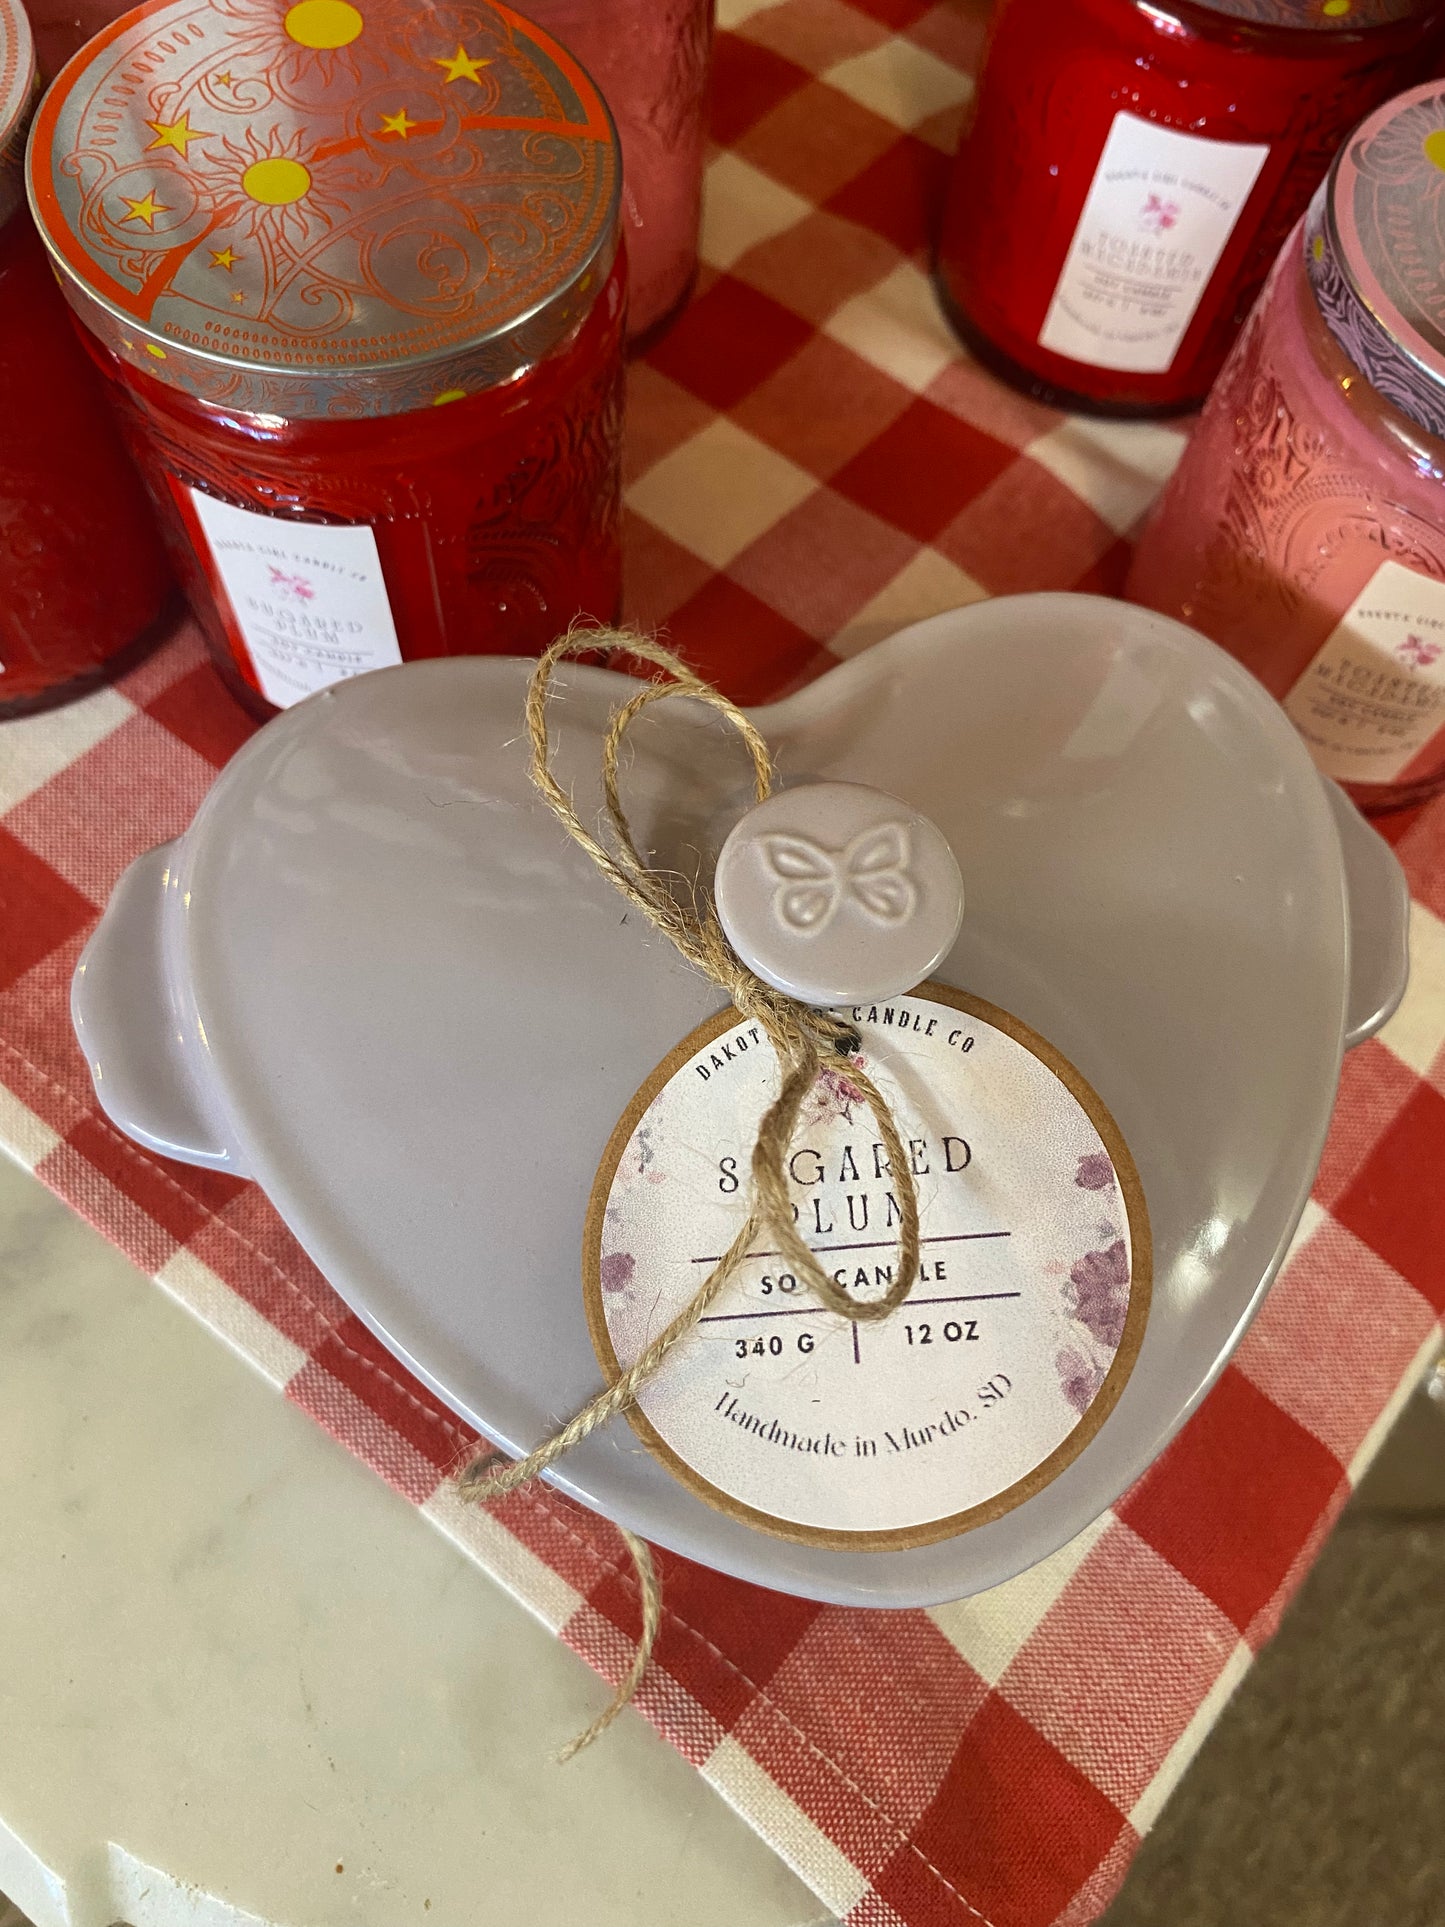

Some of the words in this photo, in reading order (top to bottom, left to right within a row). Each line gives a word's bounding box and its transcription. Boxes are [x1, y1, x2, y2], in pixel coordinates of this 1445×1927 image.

[695, 1027, 760, 1081] DAKOT
[852, 1006, 938, 1037] CANDLE
[948, 1029, 976, 1053] CO
[718, 1136, 973, 1194] SGARED
[760, 1273, 797, 1295] SO
[833, 1260, 948, 1289] CANLE
[735, 1335, 784, 1359] 340
[797, 1333, 815, 1354] G
[904, 1323, 934, 1346] 12
[943, 1320, 981, 1342] OZ
[714, 1391, 847, 1457] Handmade
[855, 1436, 877, 1457] in
[976, 1373, 1013, 1409] SD
